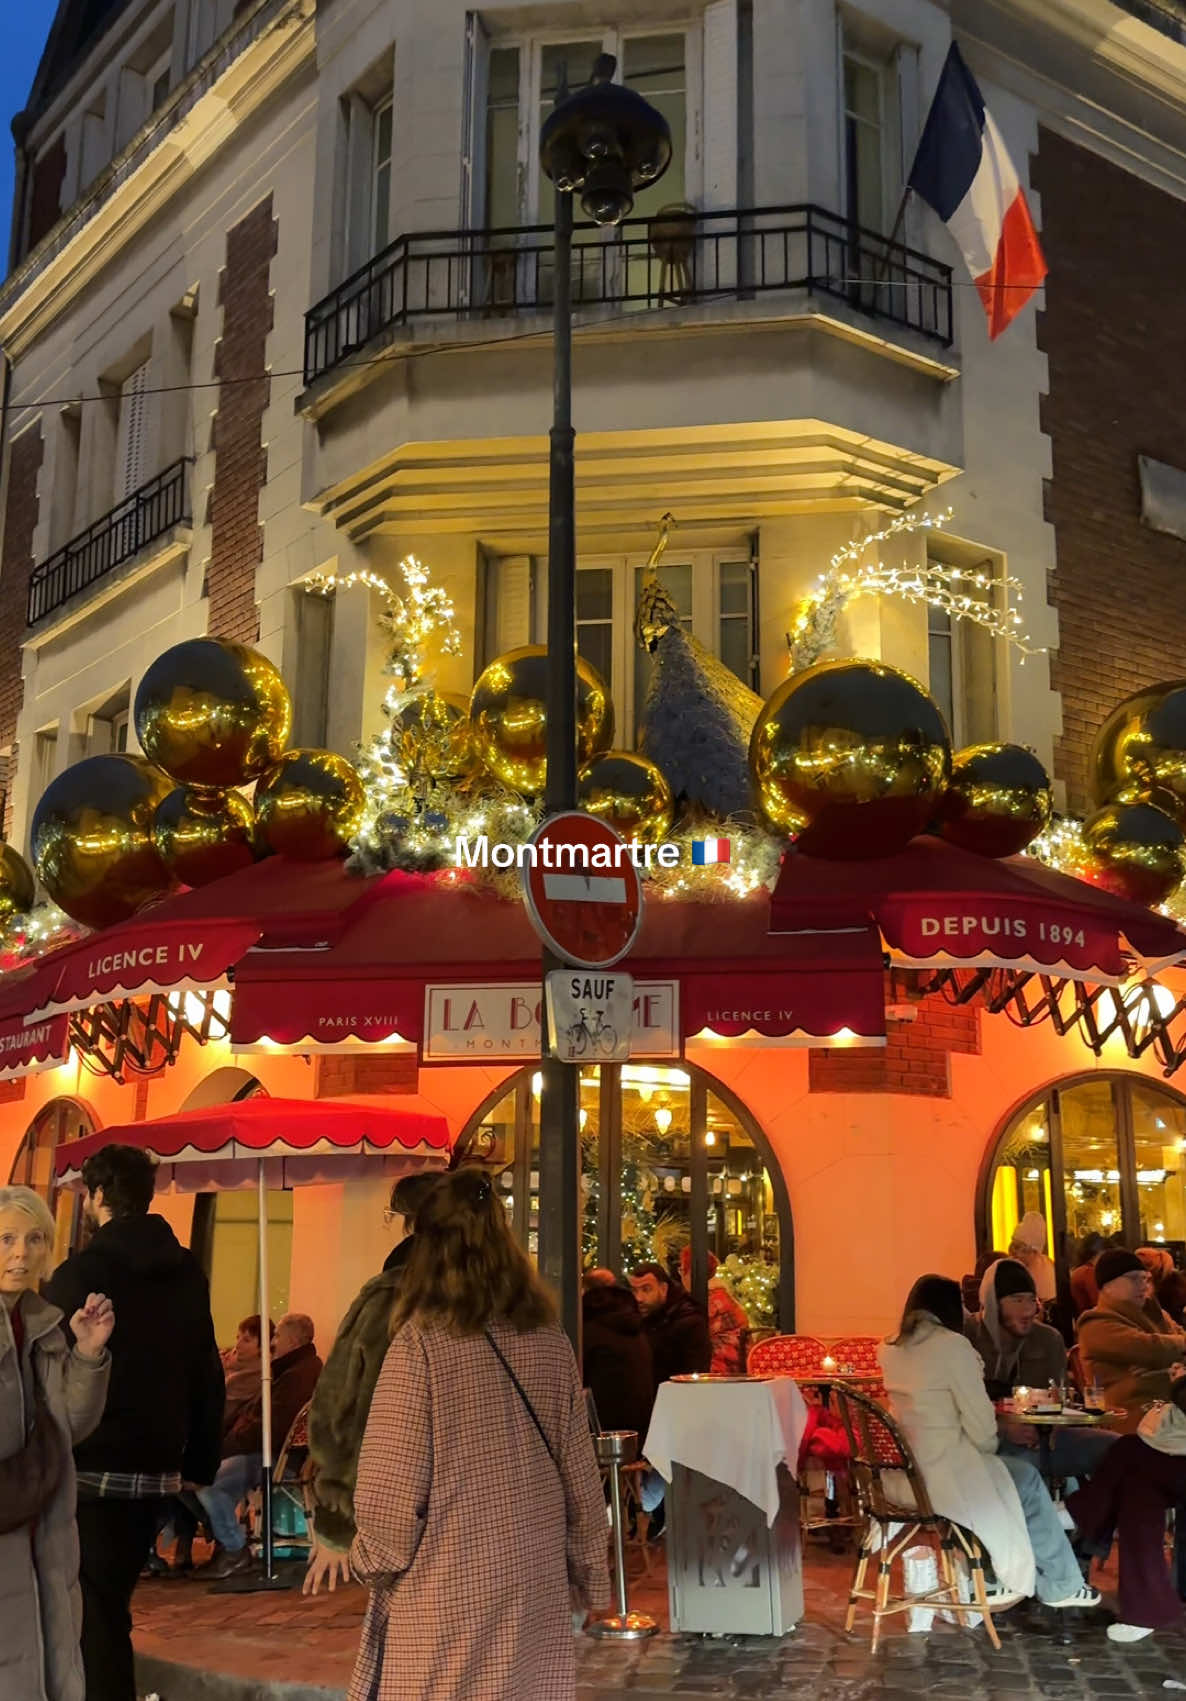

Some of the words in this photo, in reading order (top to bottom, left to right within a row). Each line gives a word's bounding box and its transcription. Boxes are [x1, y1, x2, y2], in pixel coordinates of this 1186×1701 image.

[920, 917, 1027, 938] DEPUIS
[1039, 922, 1086, 948] 1894
[88, 945, 169, 979] LICENCE
[178, 943, 204, 962] IV
[571, 977, 615, 999] SAUF
[319, 1016, 357, 1026] PARIS
[363, 1015, 398, 1025] XVIII
[442, 998, 486, 1031] LA
[706, 1010, 772, 1021] LICENCE
